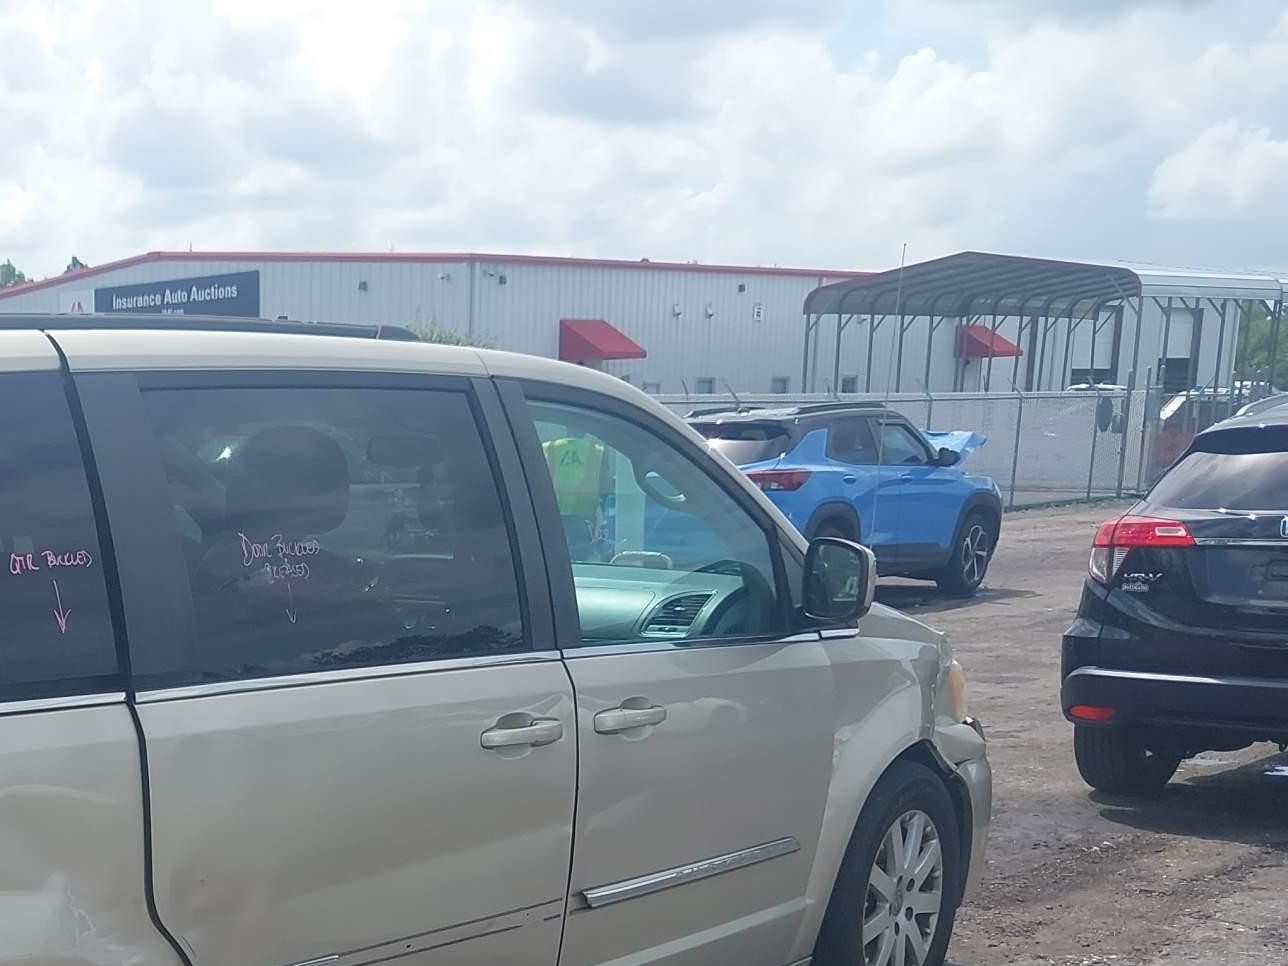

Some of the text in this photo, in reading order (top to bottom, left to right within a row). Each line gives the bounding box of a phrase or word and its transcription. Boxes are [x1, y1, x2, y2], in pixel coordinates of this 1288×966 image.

[112, 283, 238, 310] Insurance Auto Auctions
